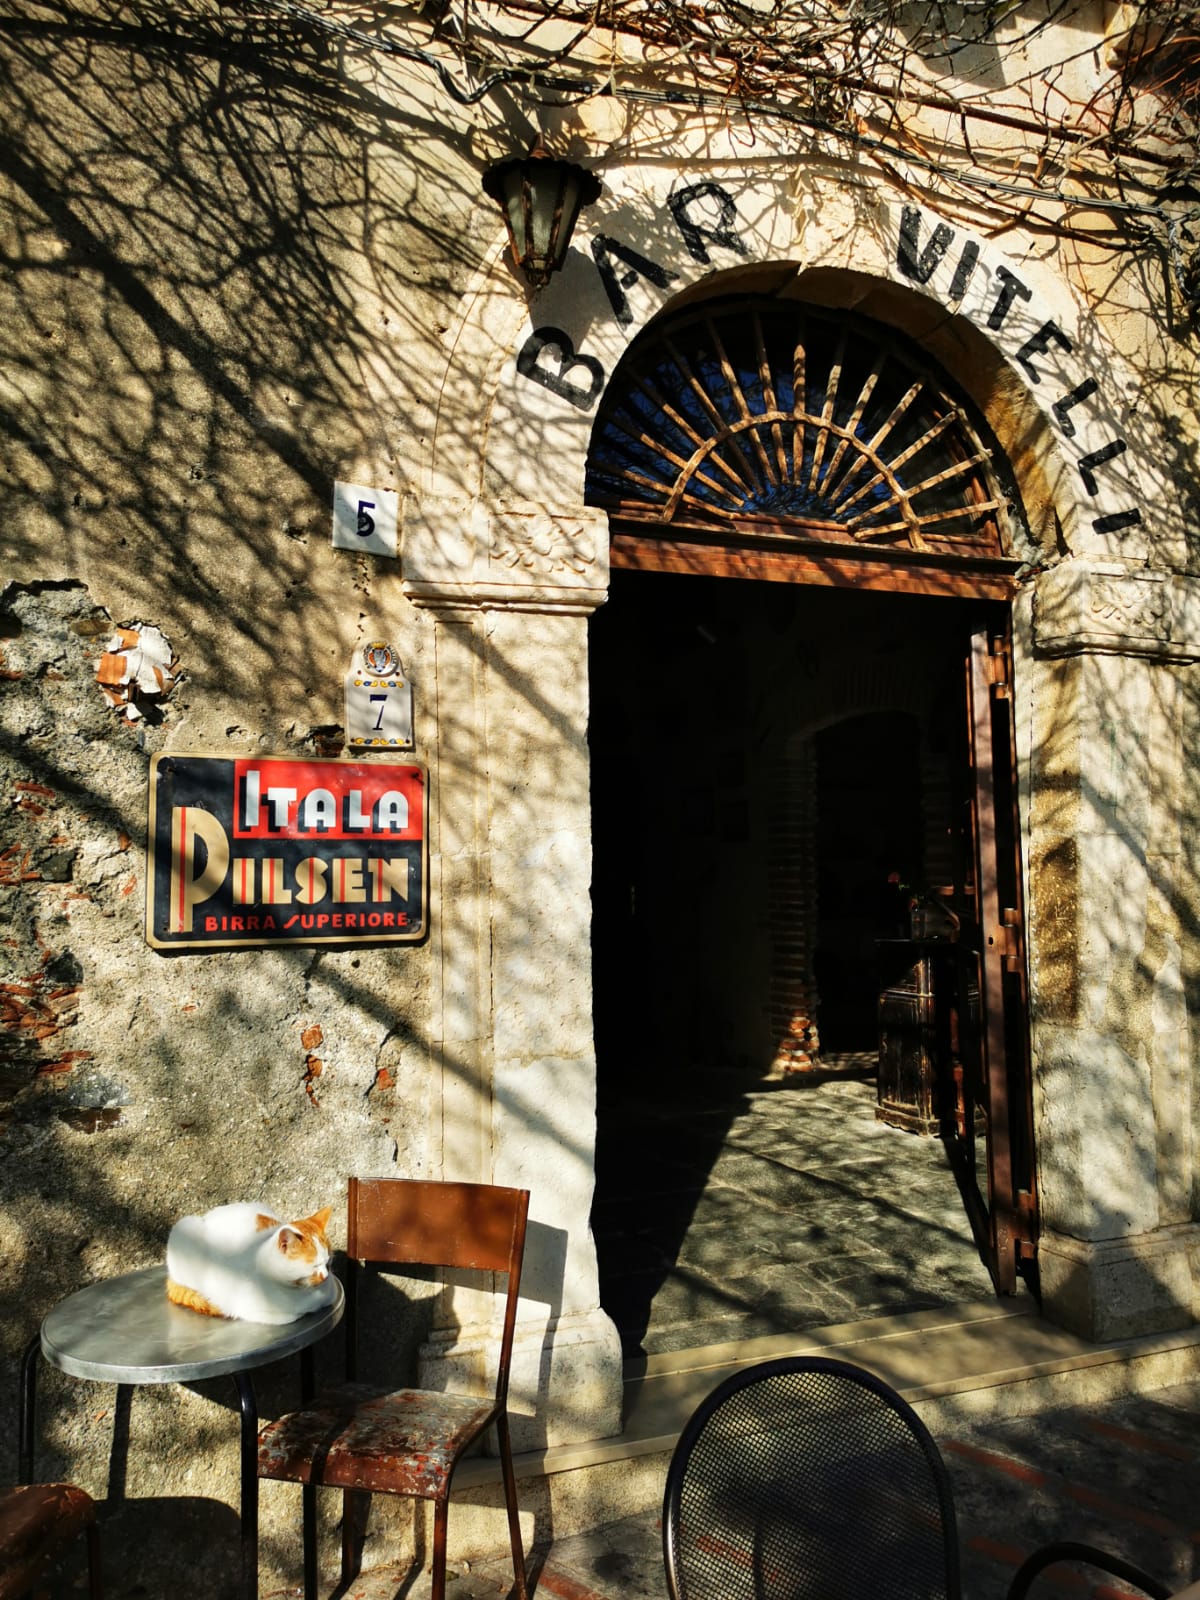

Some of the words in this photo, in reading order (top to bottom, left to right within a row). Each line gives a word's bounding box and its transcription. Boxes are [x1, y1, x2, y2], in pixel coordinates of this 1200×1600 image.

[516, 181, 752, 411] BAR
[898, 205, 1140, 535] VITELLI
[356, 500, 375, 537] 5
[369, 694, 388, 731] 7
[244, 770, 409, 829] ITALA
[170, 806, 409, 933] PILSEN
[205, 915, 276, 932] BIRRA
[283, 912, 408, 929] SUPERIORE
